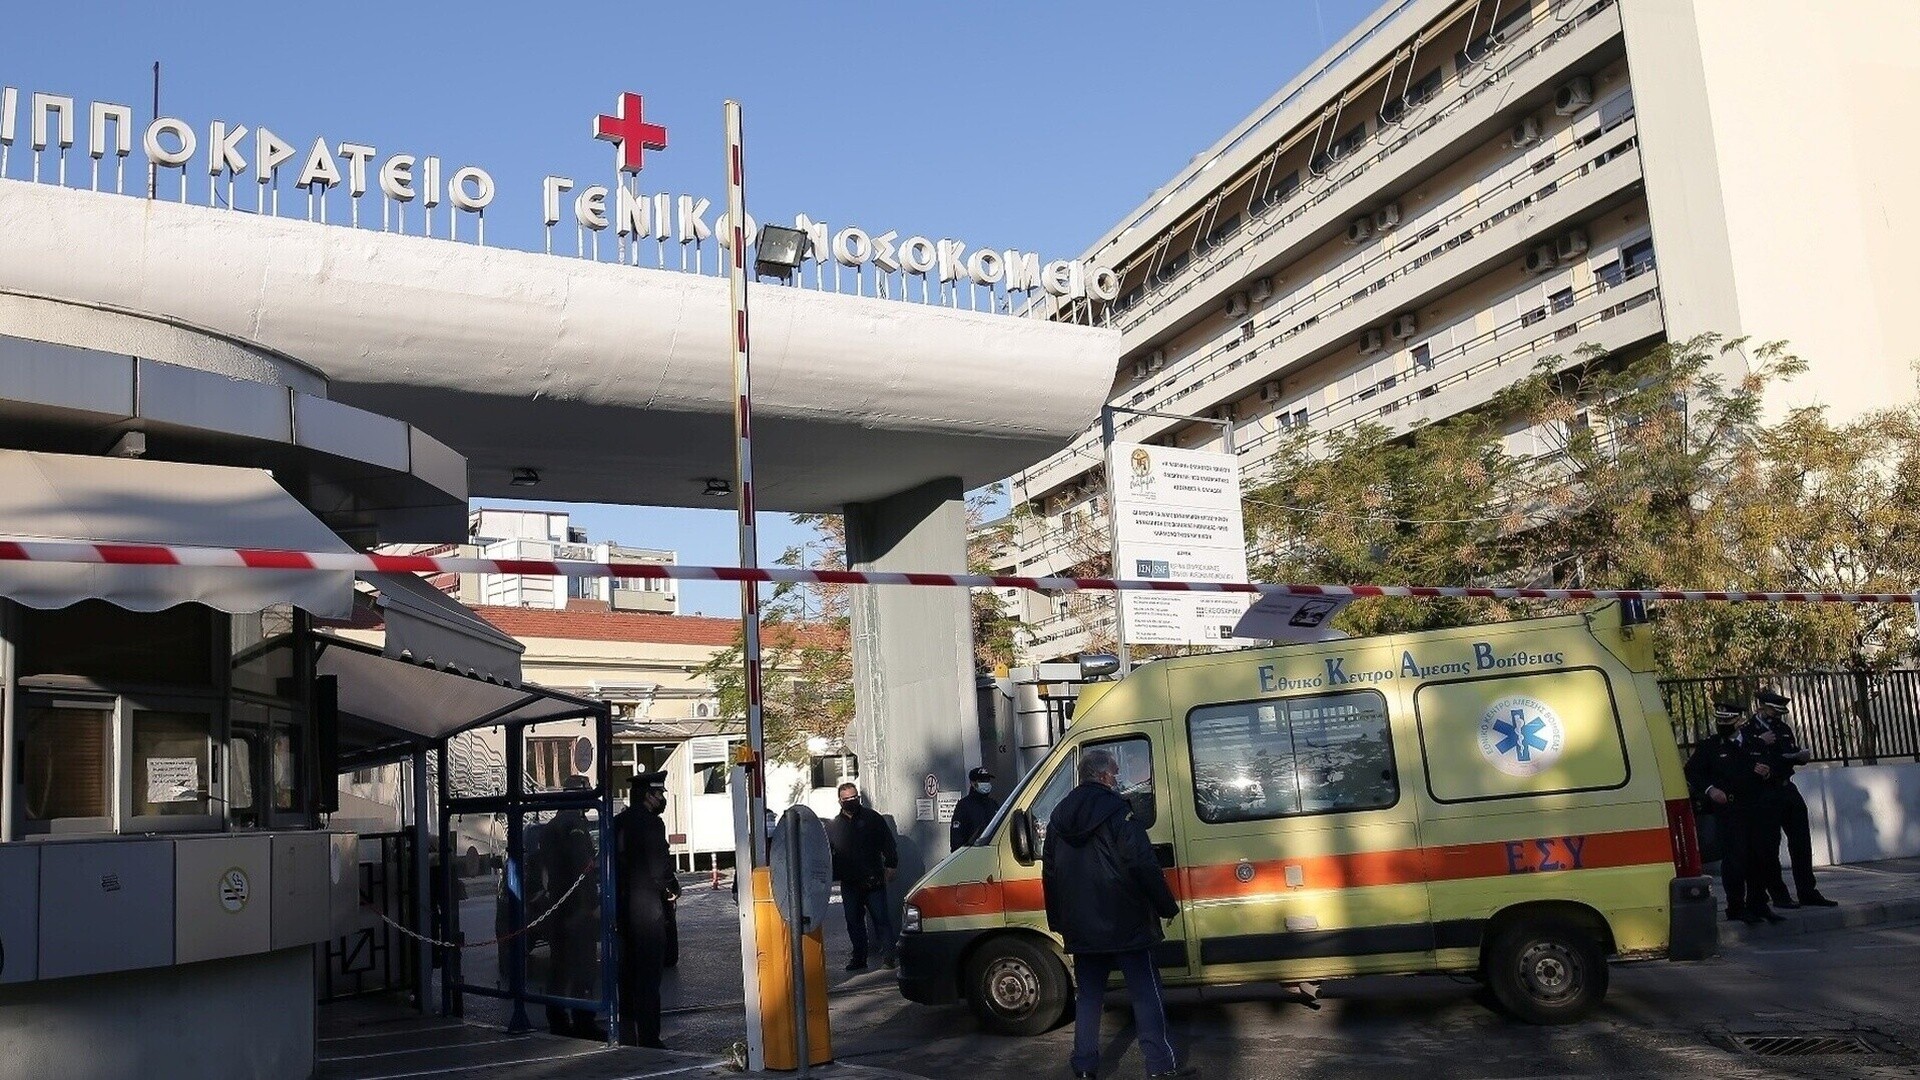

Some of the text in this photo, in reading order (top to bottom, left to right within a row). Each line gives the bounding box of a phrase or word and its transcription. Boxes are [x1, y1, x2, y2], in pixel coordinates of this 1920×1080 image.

[0, 87, 495, 213] ΙΠΠΟΚΡΑΤΕΙΟ
[1258, 641, 1564, 693] Εθνικό Κεντρο Αμεσης Βοήθειας
